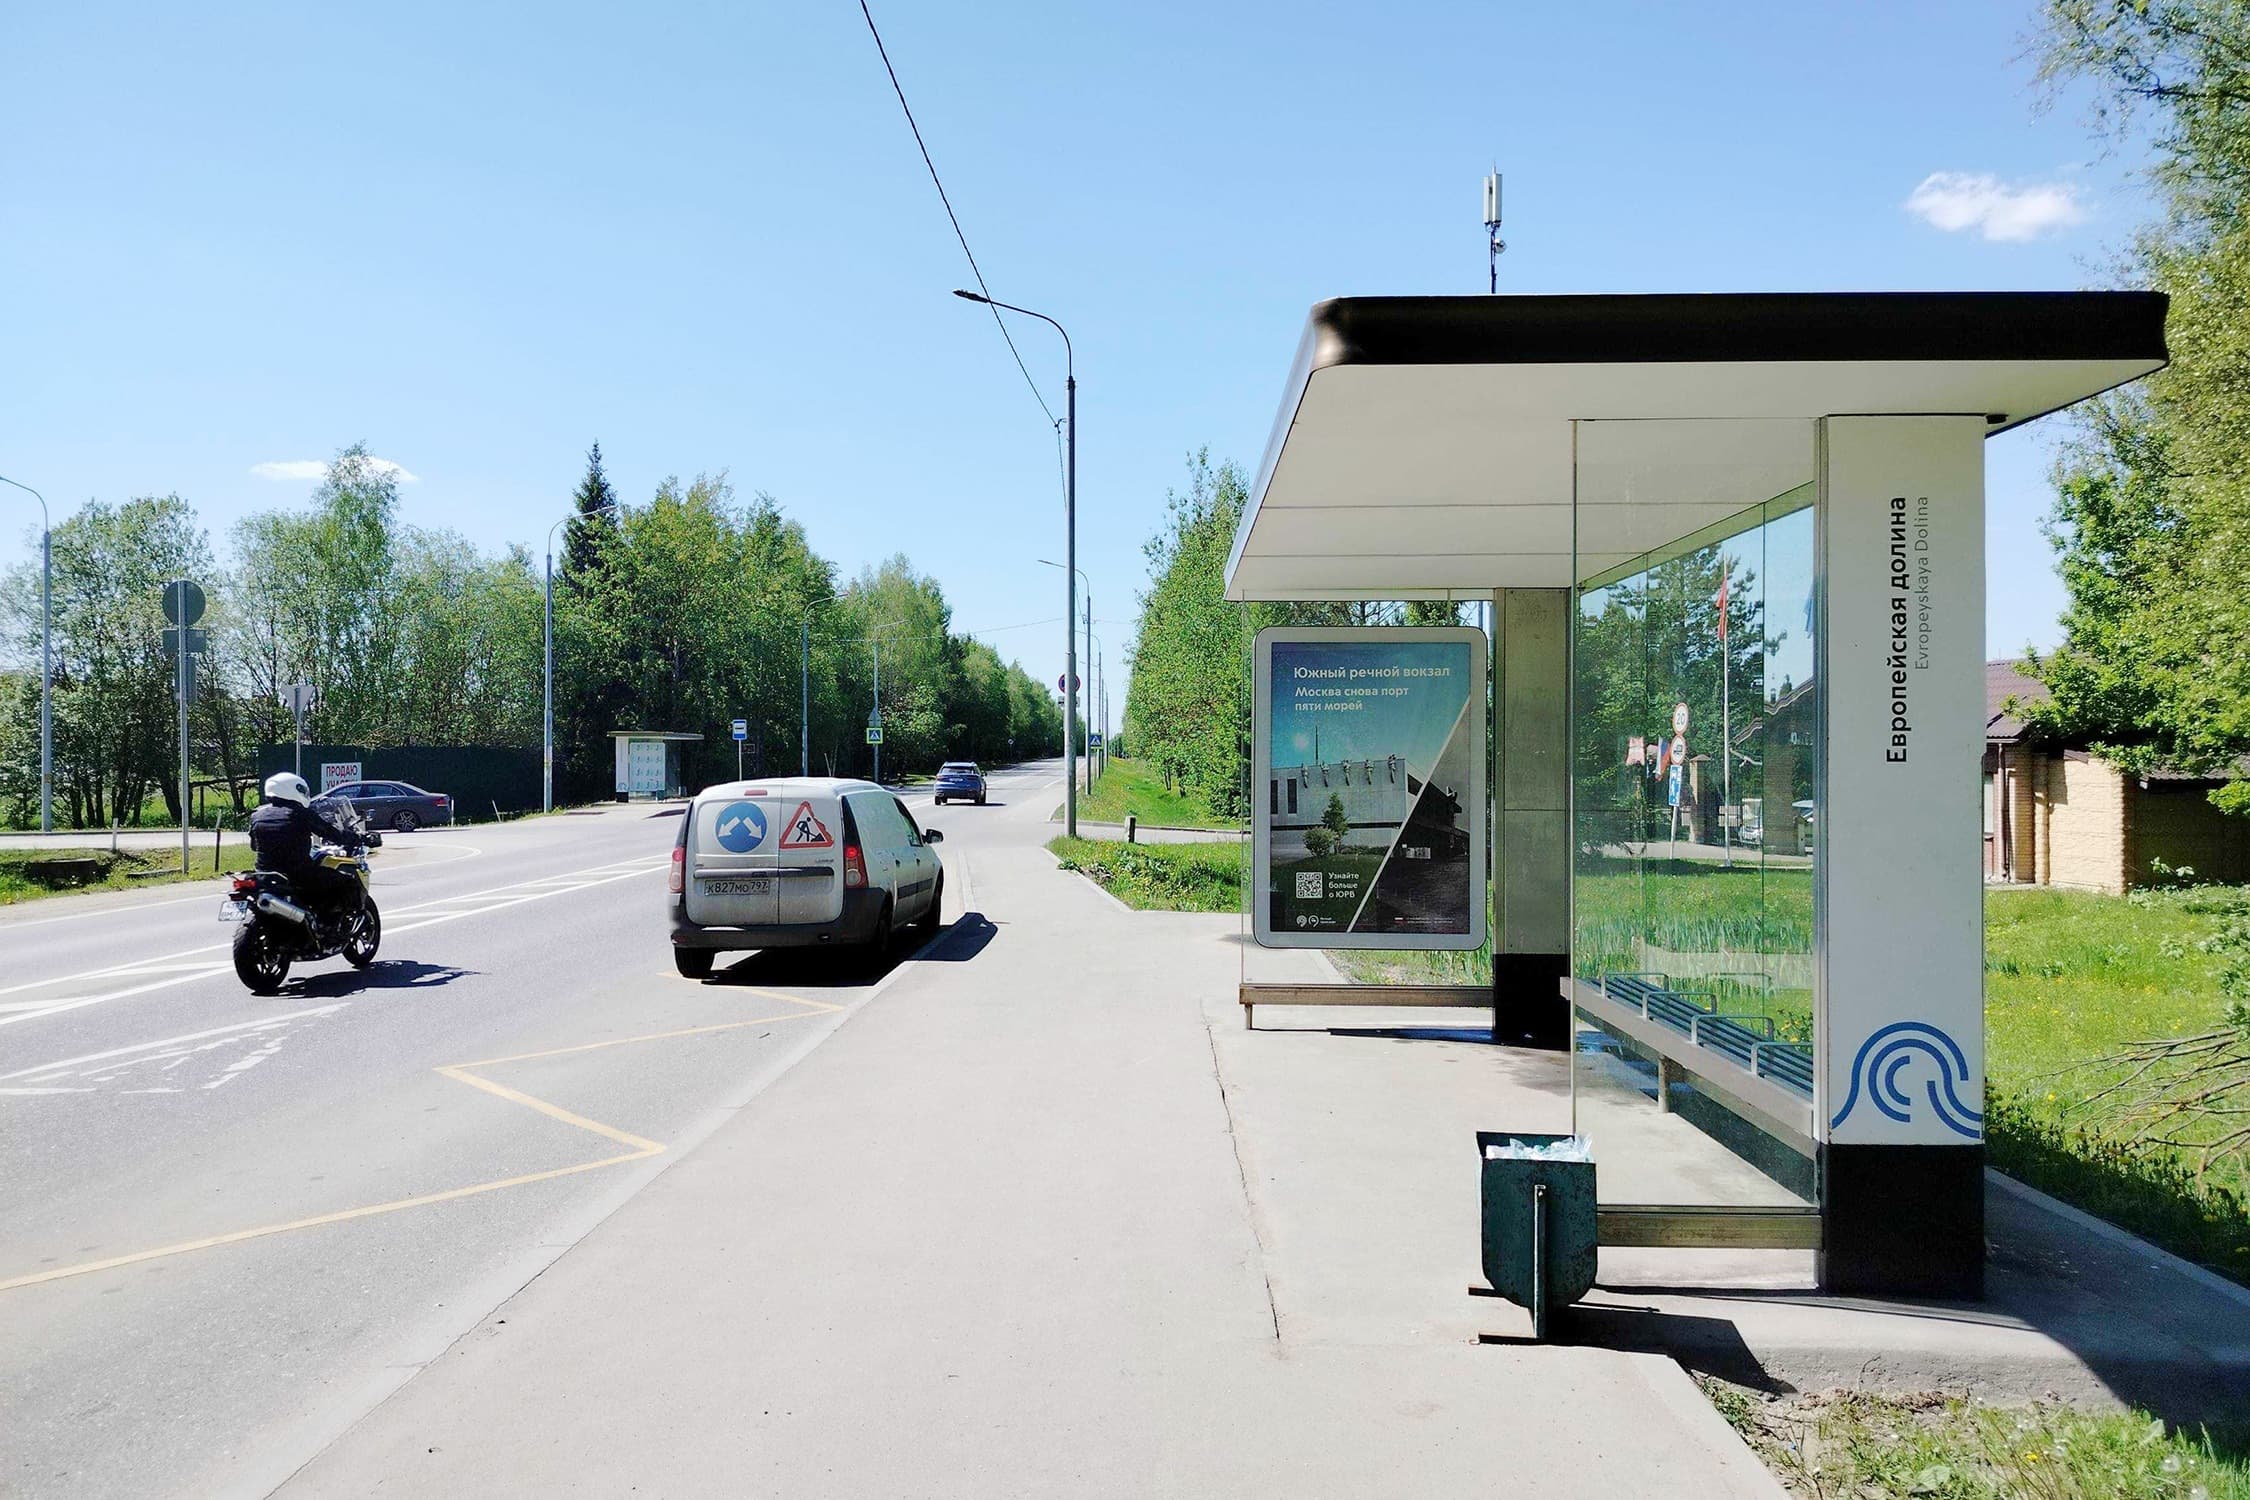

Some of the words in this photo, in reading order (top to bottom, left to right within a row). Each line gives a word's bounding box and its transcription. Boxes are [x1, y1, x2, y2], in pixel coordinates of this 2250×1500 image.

[1914, 496, 1928, 552] Dolina
[1891, 496, 1910, 590] долина
[1914, 556, 1932, 670] Evropeyskaya
[1294, 666, 1346, 679] Южный
[1349, 665, 1400, 681] речной
[1403, 667, 1450, 678] вокзал
[1886, 597, 1912, 763] Европейская
[1295, 687, 1342, 697] Москва
[1344, 687, 1379, 697] снова
[1381, 686, 1409, 698] порт
[1295, 702, 1322, 711] пяти
[1324, 700, 1363, 712] морей
[326, 765, 358, 778] ПРОДАЮ
[1328, 871, 1360, 880] Узнайте
[1328, 881, 1358, 889] больше
